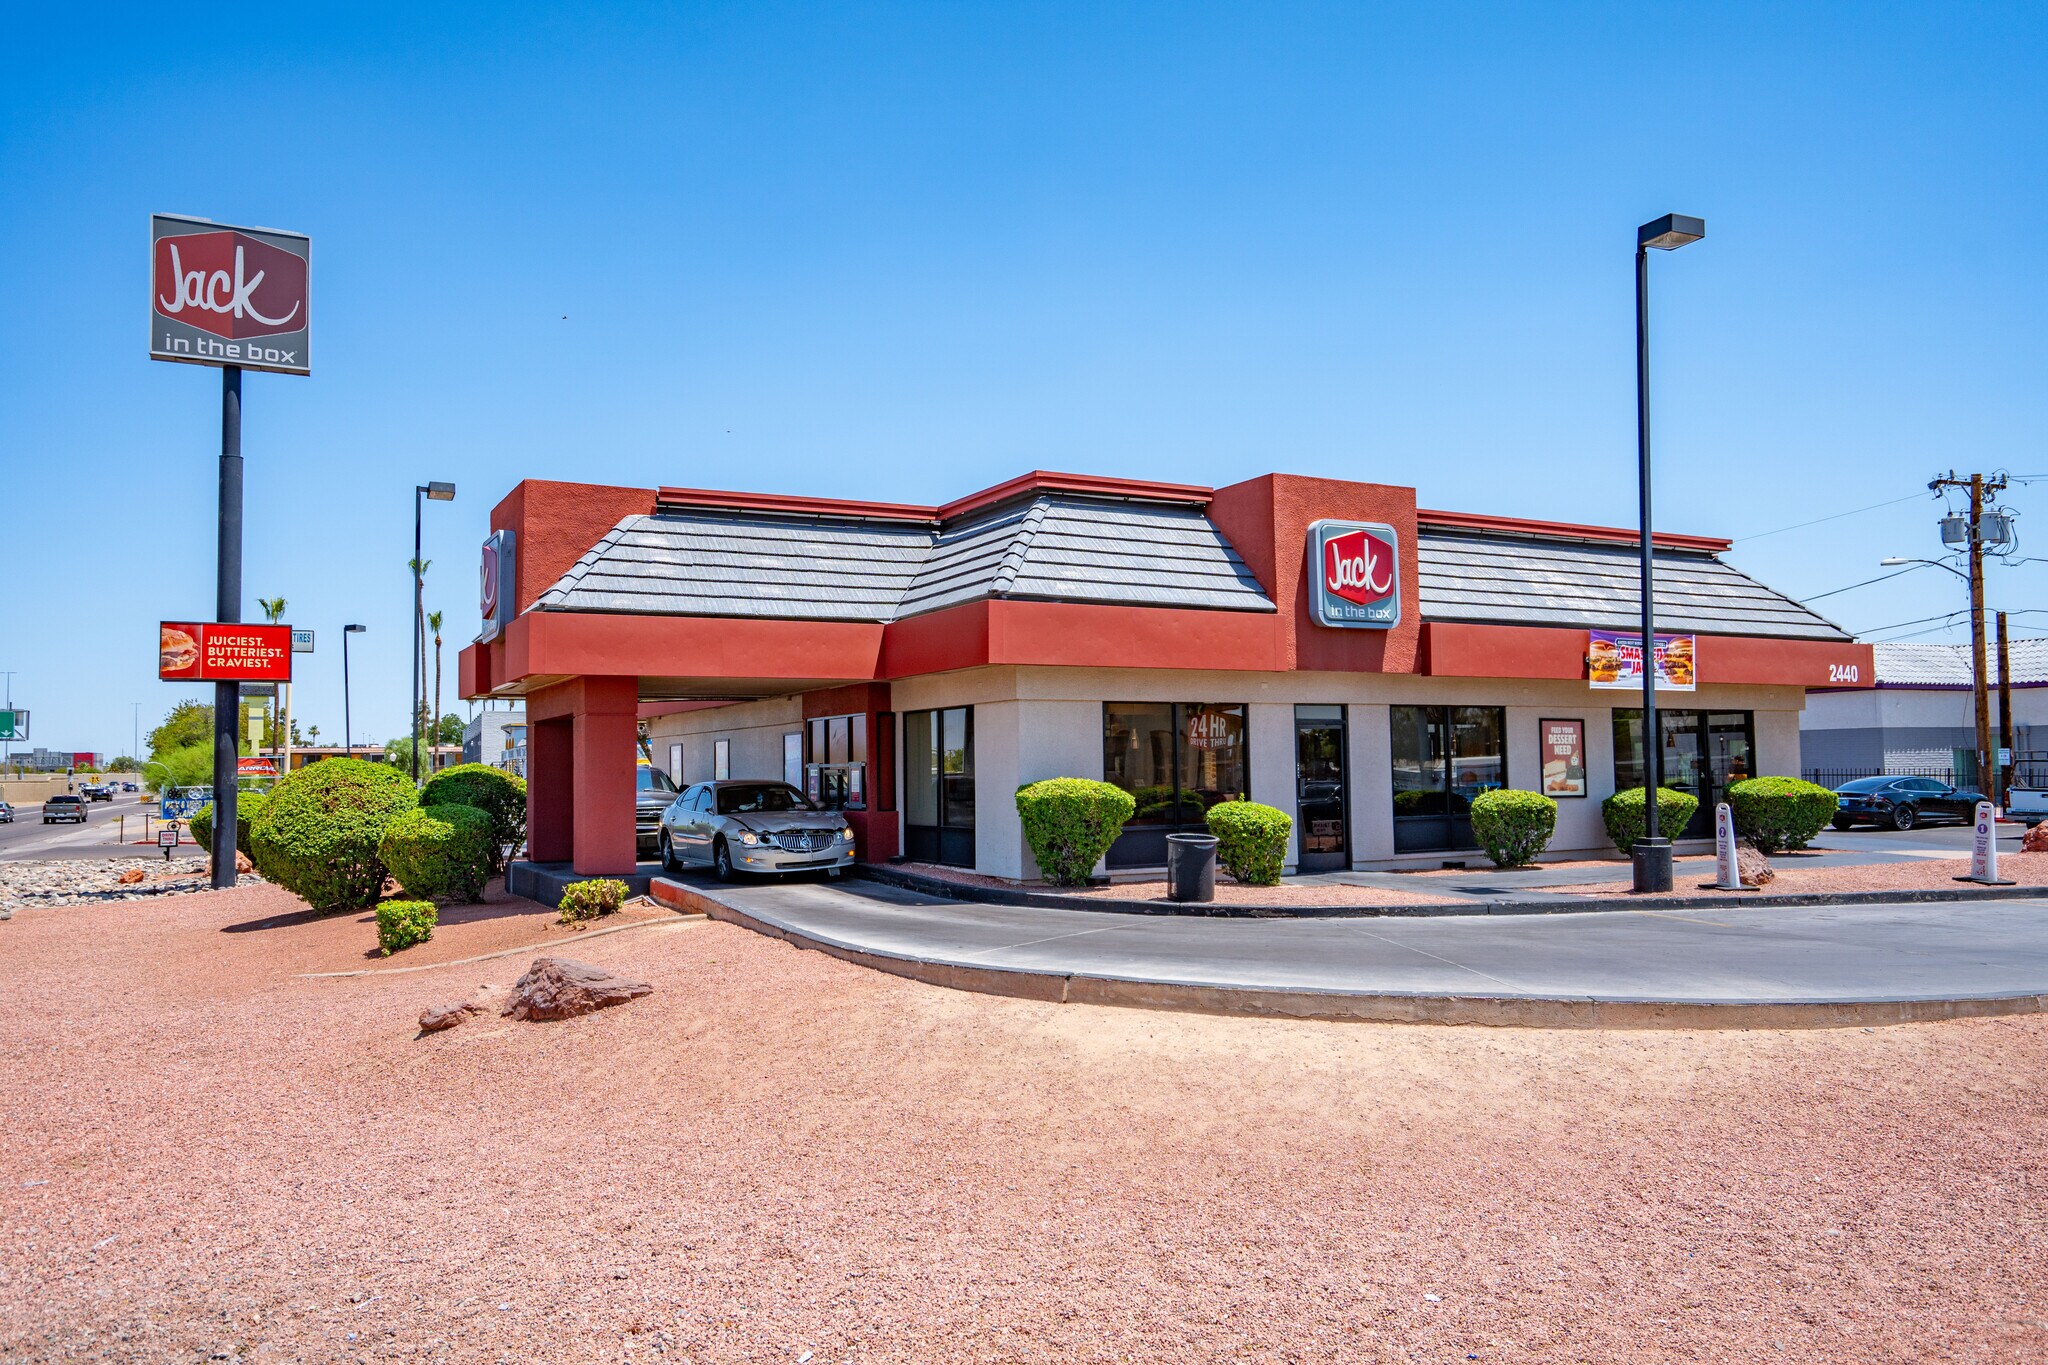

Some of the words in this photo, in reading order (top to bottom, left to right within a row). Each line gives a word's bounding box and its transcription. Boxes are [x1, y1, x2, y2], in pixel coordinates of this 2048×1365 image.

[160, 243, 300, 326] Jack
[165, 333, 189, 353] in
[197, 337, 240, 358] the
[247, 343, 296, 364] box
[1328, 538, 1392, 593] Jack
[1331, 604, 1343, 617] in
[1345, 606, 1365, 618] the
[1368, 607, 1392, 619] box
[207, 635, 265, 647] JUICIEST.
[292, 633, 311, 643] TIRES
[208, 647, 284, 658] BUTTERIEST.
[207, 657, 271, 668] CRAVIEST.
[1829, 664, 1858, 683] 2440
[1191, 714, 1208, 737] 24
[1210, 714, 1226, 737] HR
[1551, 726, 1561, 734] FEED
[1190, 738, 1208, 748] DRIVE
[1210, 738, 1227, 748] THRU
[1548, 734, 1577, 745] DESSERT
[1554, 745, 1572, 755] NEED
